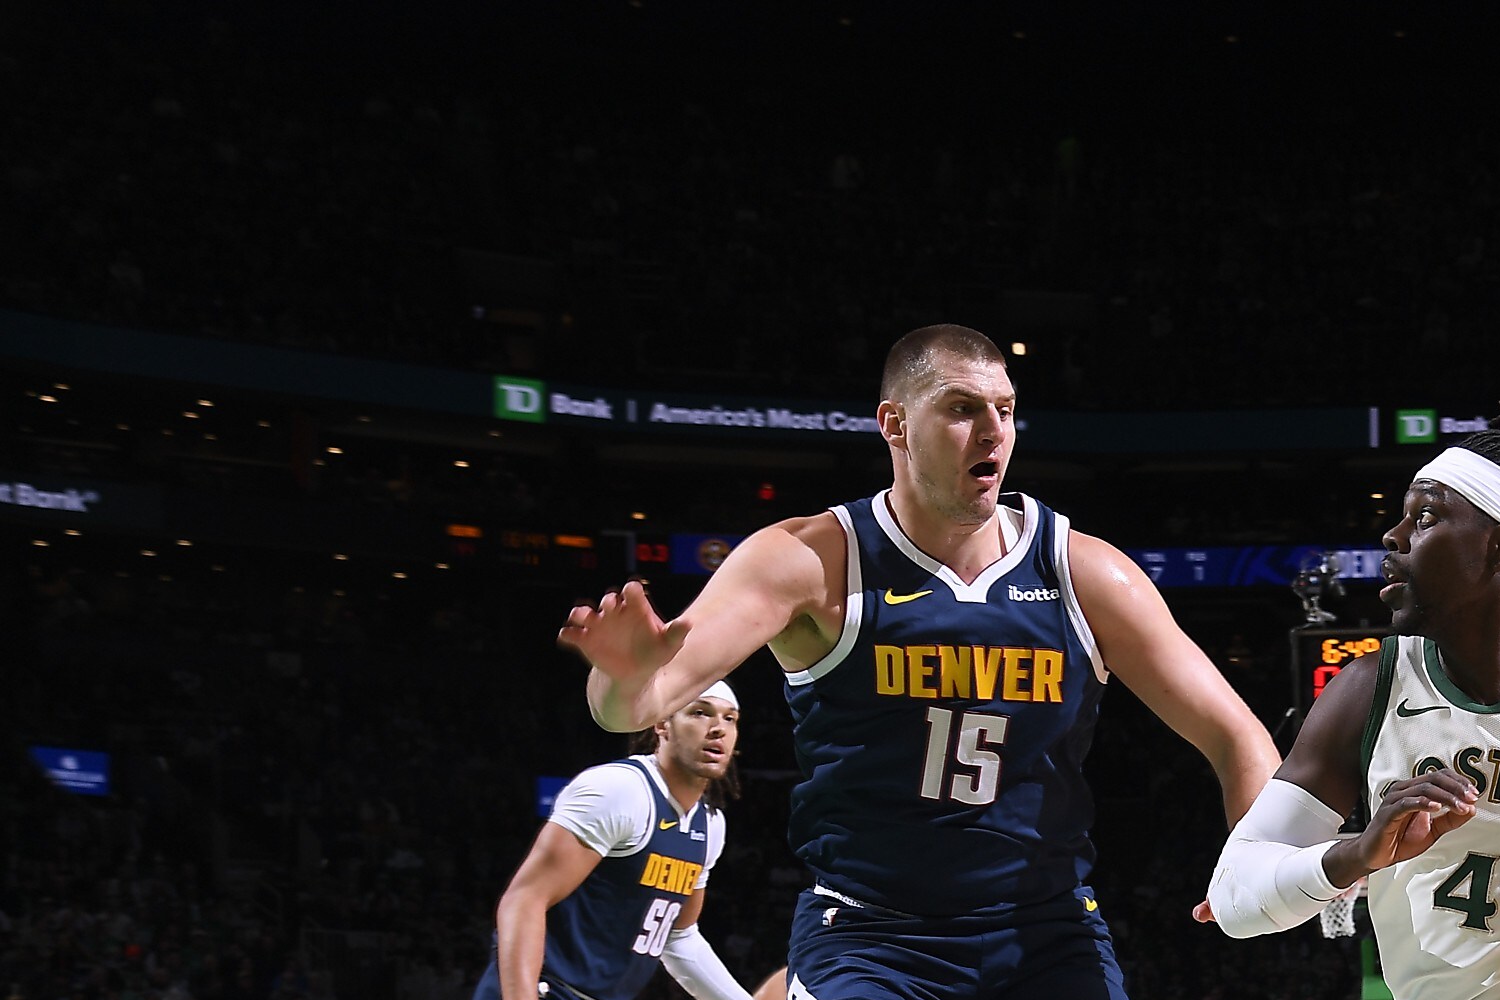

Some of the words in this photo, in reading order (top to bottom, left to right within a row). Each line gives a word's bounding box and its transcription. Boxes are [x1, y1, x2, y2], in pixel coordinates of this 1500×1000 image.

[1008, 584, 1060, 603] ibotta
[873, 644, 1065, 704] DENVER
[919, 706, 1010, 806] 15
[639, 852, 704, 896] DENVE
[1432, 850, 1500, 935] 4
[632, 898, 682, 957] 50
